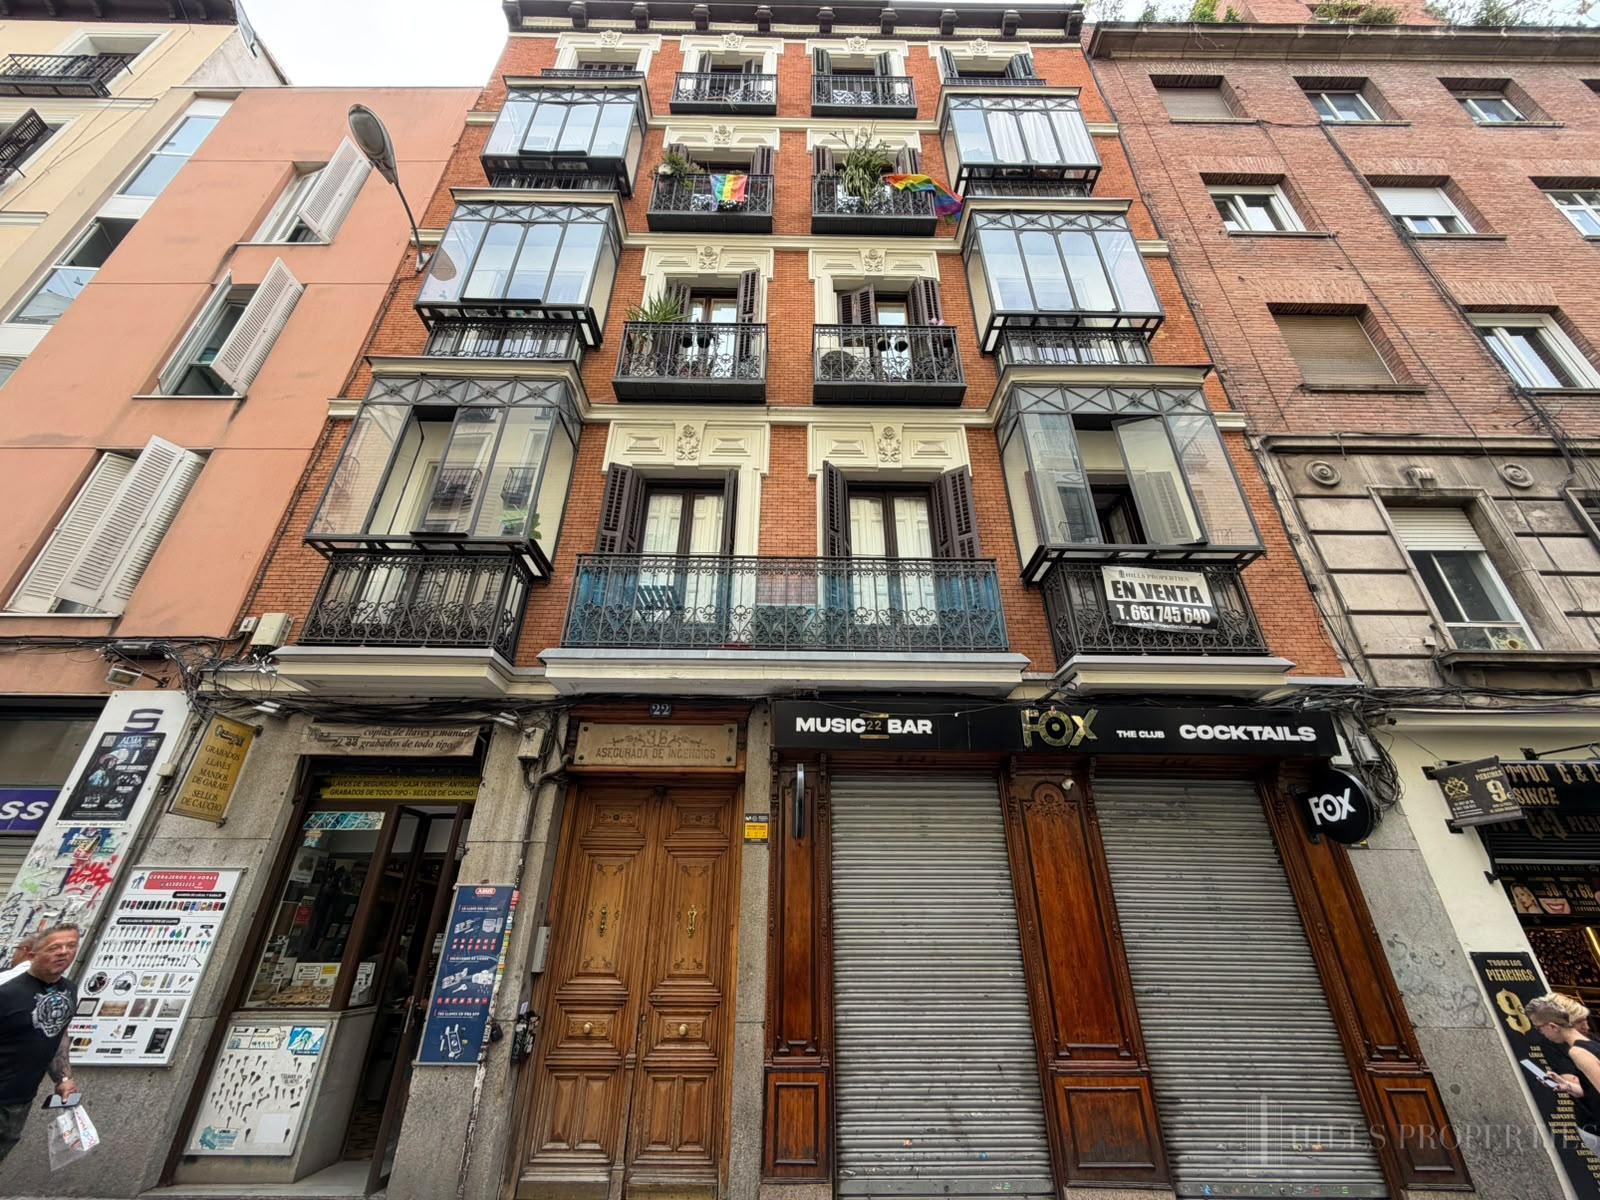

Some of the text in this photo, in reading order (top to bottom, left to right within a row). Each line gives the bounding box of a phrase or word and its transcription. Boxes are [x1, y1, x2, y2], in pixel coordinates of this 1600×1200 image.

[1111, 580, 1205, 604] EN VENTA
[1116, 604, 1211, 625] T. 667 745 640
[652, 703, 671, 716] 22
[363, 727, 391, 738] copias
[391, 727, 403, 737] de
[406, 727, 431, 738] llaves
[796, 717, 932, 734] MUSIC BAR
[866, 720, 882, 731] 22
[1021, 706, 1099, 748] FOX
[1116, 730, 1165, 739] THE CLUB
[1179, 724, 1317, 742] COCKTAILS
[359, 738, 400, 750] grabados
[401, 738, 413, 748] de
[414, 738, 433, 749] todo
[205, 744, 241, 761] GRABADOS
[595, 747, 716, 760] ASEGURADA DE INCENDIOS
[206, 757, 232, 771] LLAVES
[200, 768, 228, 782] MANDOS
[192, 775, 230, 792] DE GARAJE
[352, 780, 363, 788] DE
[364, 780, 398, 789] SEGURIDAD
[192, 790, 218, 801] SELLOS
[413, 789, 434, 797] SELLOS
[435, 789, 447, 797] DE
[447, 789, 474, 797] CAUCHO
[1512, 786, 1560, 806] SINCE
[181, 796, 223, 812] DE CAUCHO
[1307, 787, 1357, 826] FOX
[1485, 968, 1536, 982] PIERCINGS
